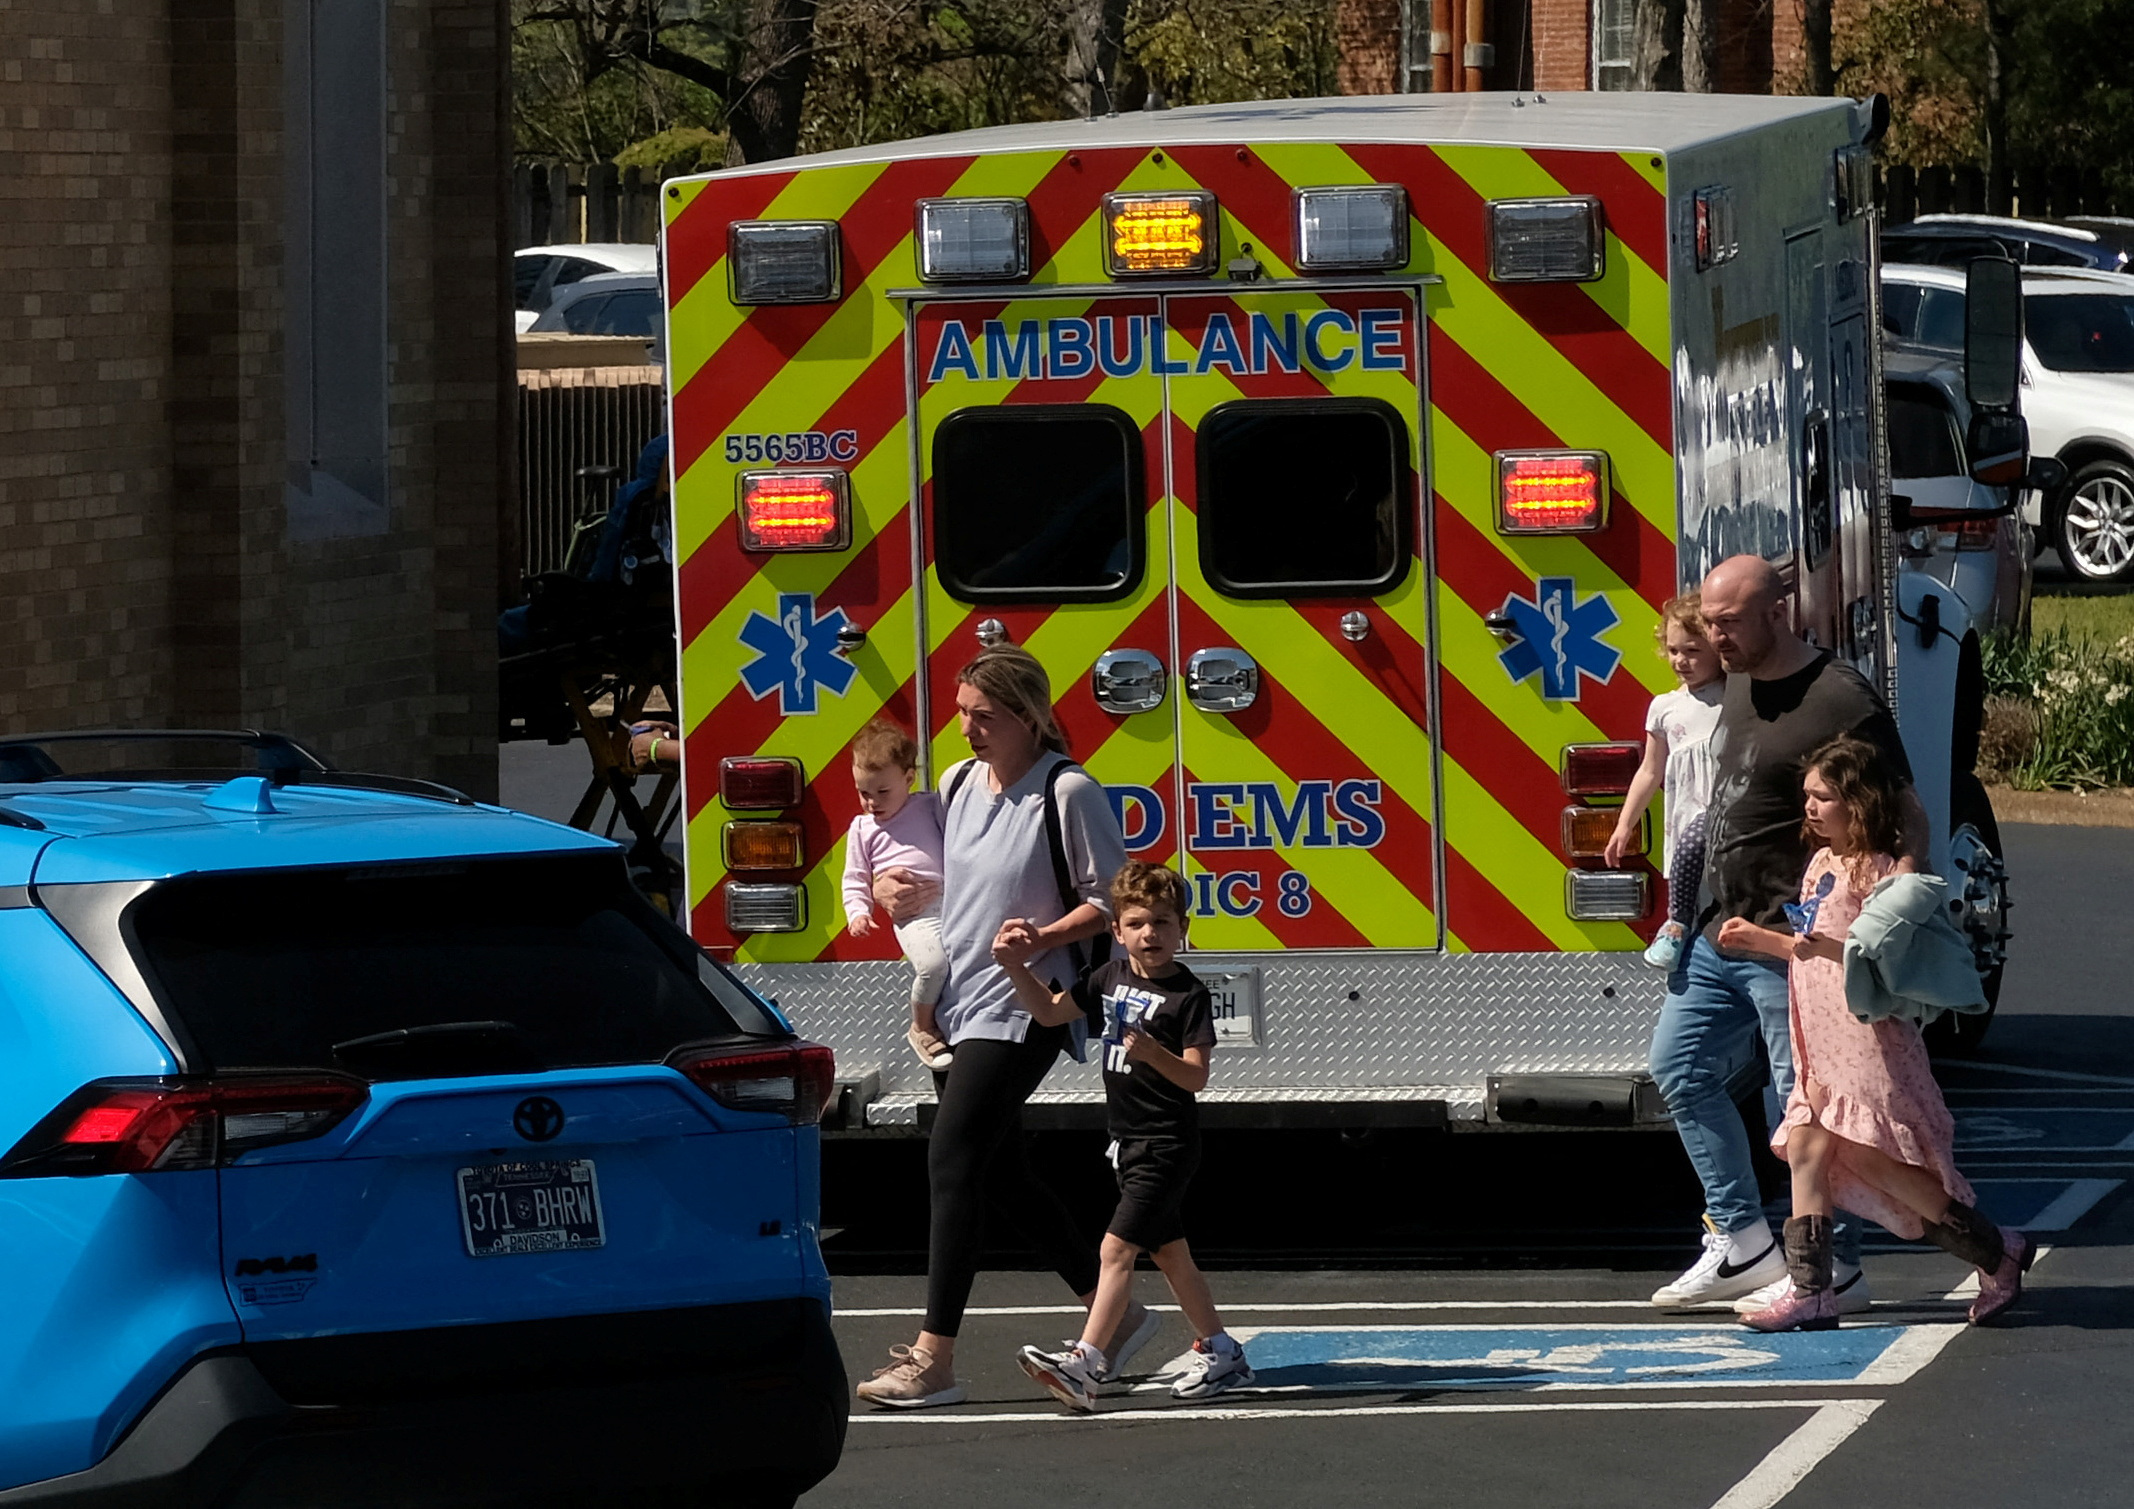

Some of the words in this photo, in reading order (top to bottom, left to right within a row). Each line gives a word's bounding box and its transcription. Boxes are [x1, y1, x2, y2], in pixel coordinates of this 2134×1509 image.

[927, 309, 1407, 383] AMBULANCE
[724, 429, 858, 464] 5565BC
[1187, 779, 1386, 850] EMS
[1184, 871, 1263, 918] IC
[1277, 870, 1312, 918] 8
[469, 1191, 516, 1231] 371
[533, 1185, 593, 1228] BHRW
[509, 1231, 560, 1246] DAVIDSON
